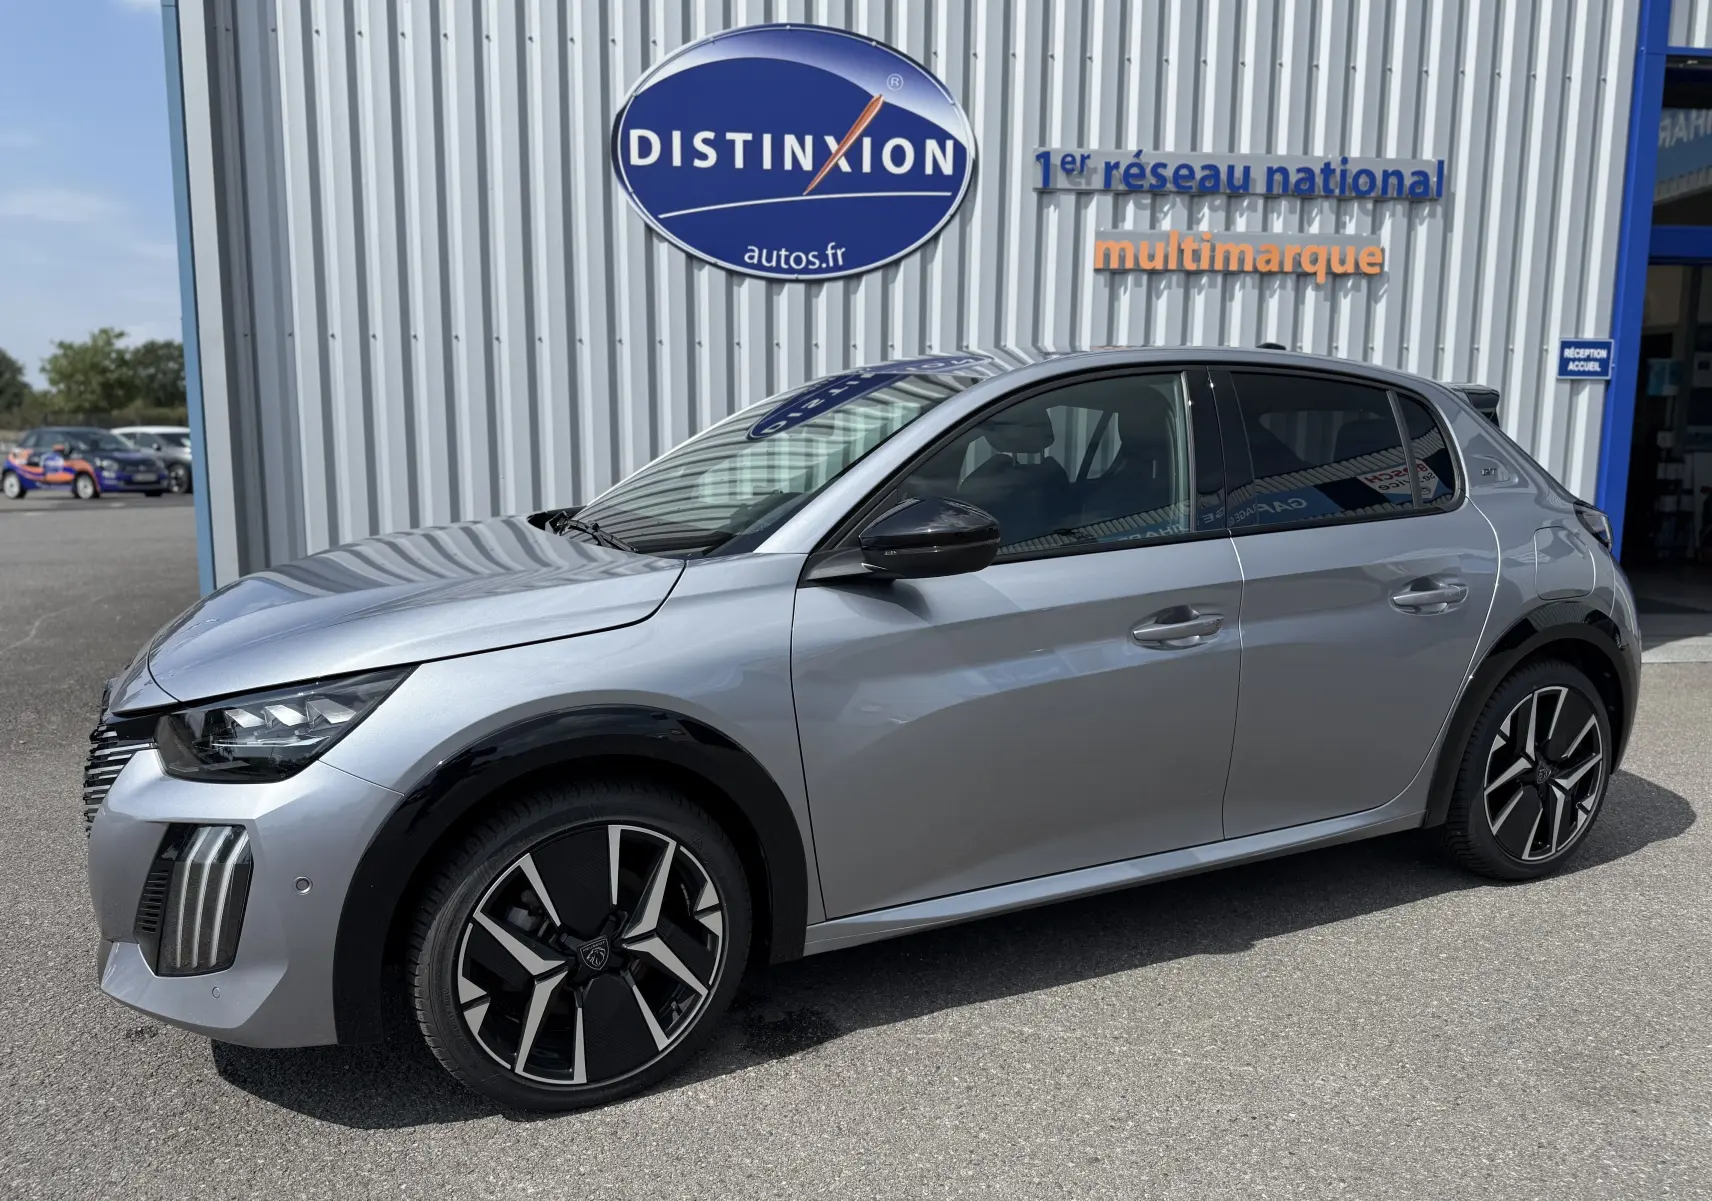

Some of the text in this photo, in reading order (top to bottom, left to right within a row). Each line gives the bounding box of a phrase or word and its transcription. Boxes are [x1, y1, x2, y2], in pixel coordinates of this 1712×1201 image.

[629, 128, 955, 176] DISTINXION
[1035, 148, 1445, 199] 1er réseau national
[743, 241, 847, 270] autos.fr
[1093, 229, 1384, 285] multimarque
[1563, 346, 1608, 359] RÉCEPTION
[1567, 361, 1601, 371] ACCUEIL
